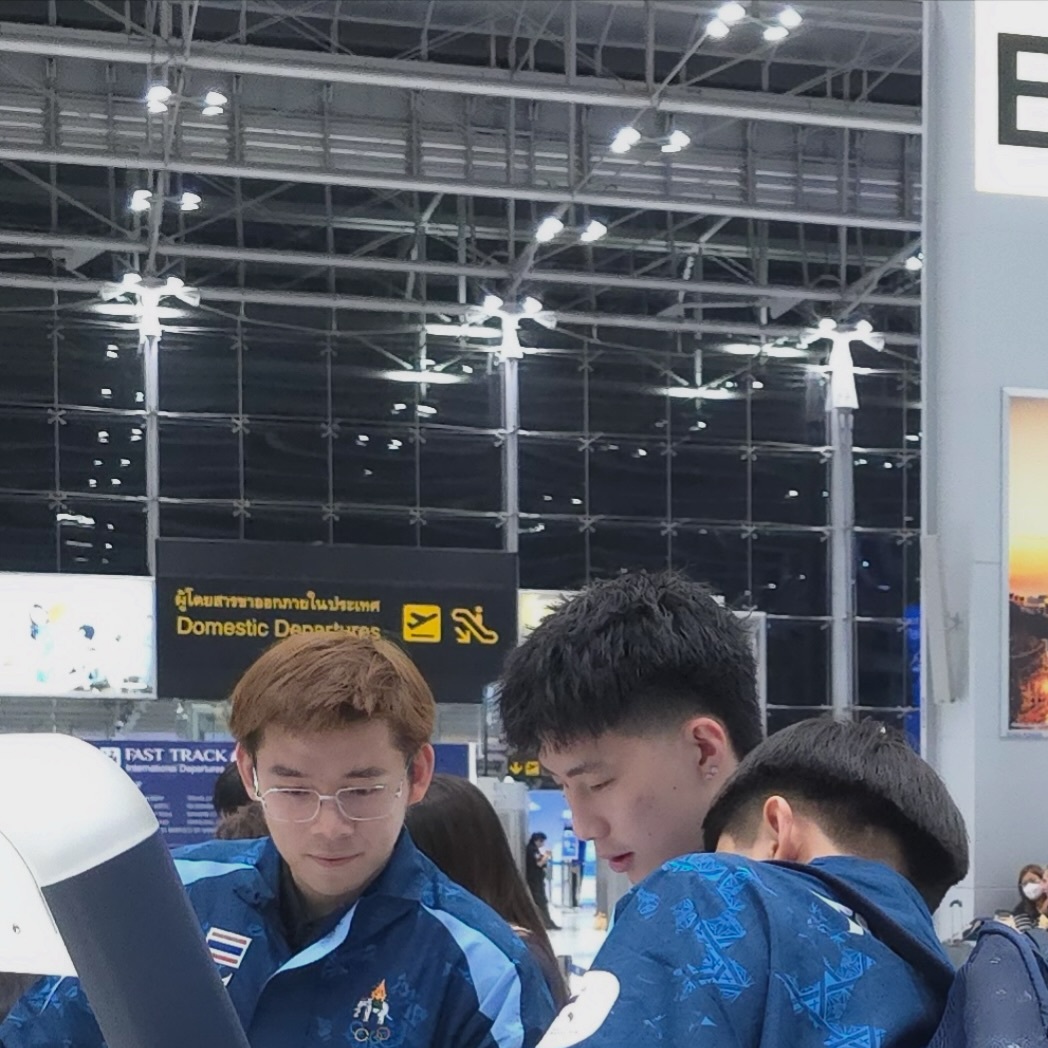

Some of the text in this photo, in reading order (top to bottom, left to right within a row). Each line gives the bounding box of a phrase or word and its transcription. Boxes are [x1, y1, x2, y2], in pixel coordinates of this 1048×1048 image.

[177, 615, 270, 637] Domestic
[125, 747, 229, 763] FAST TRACK
